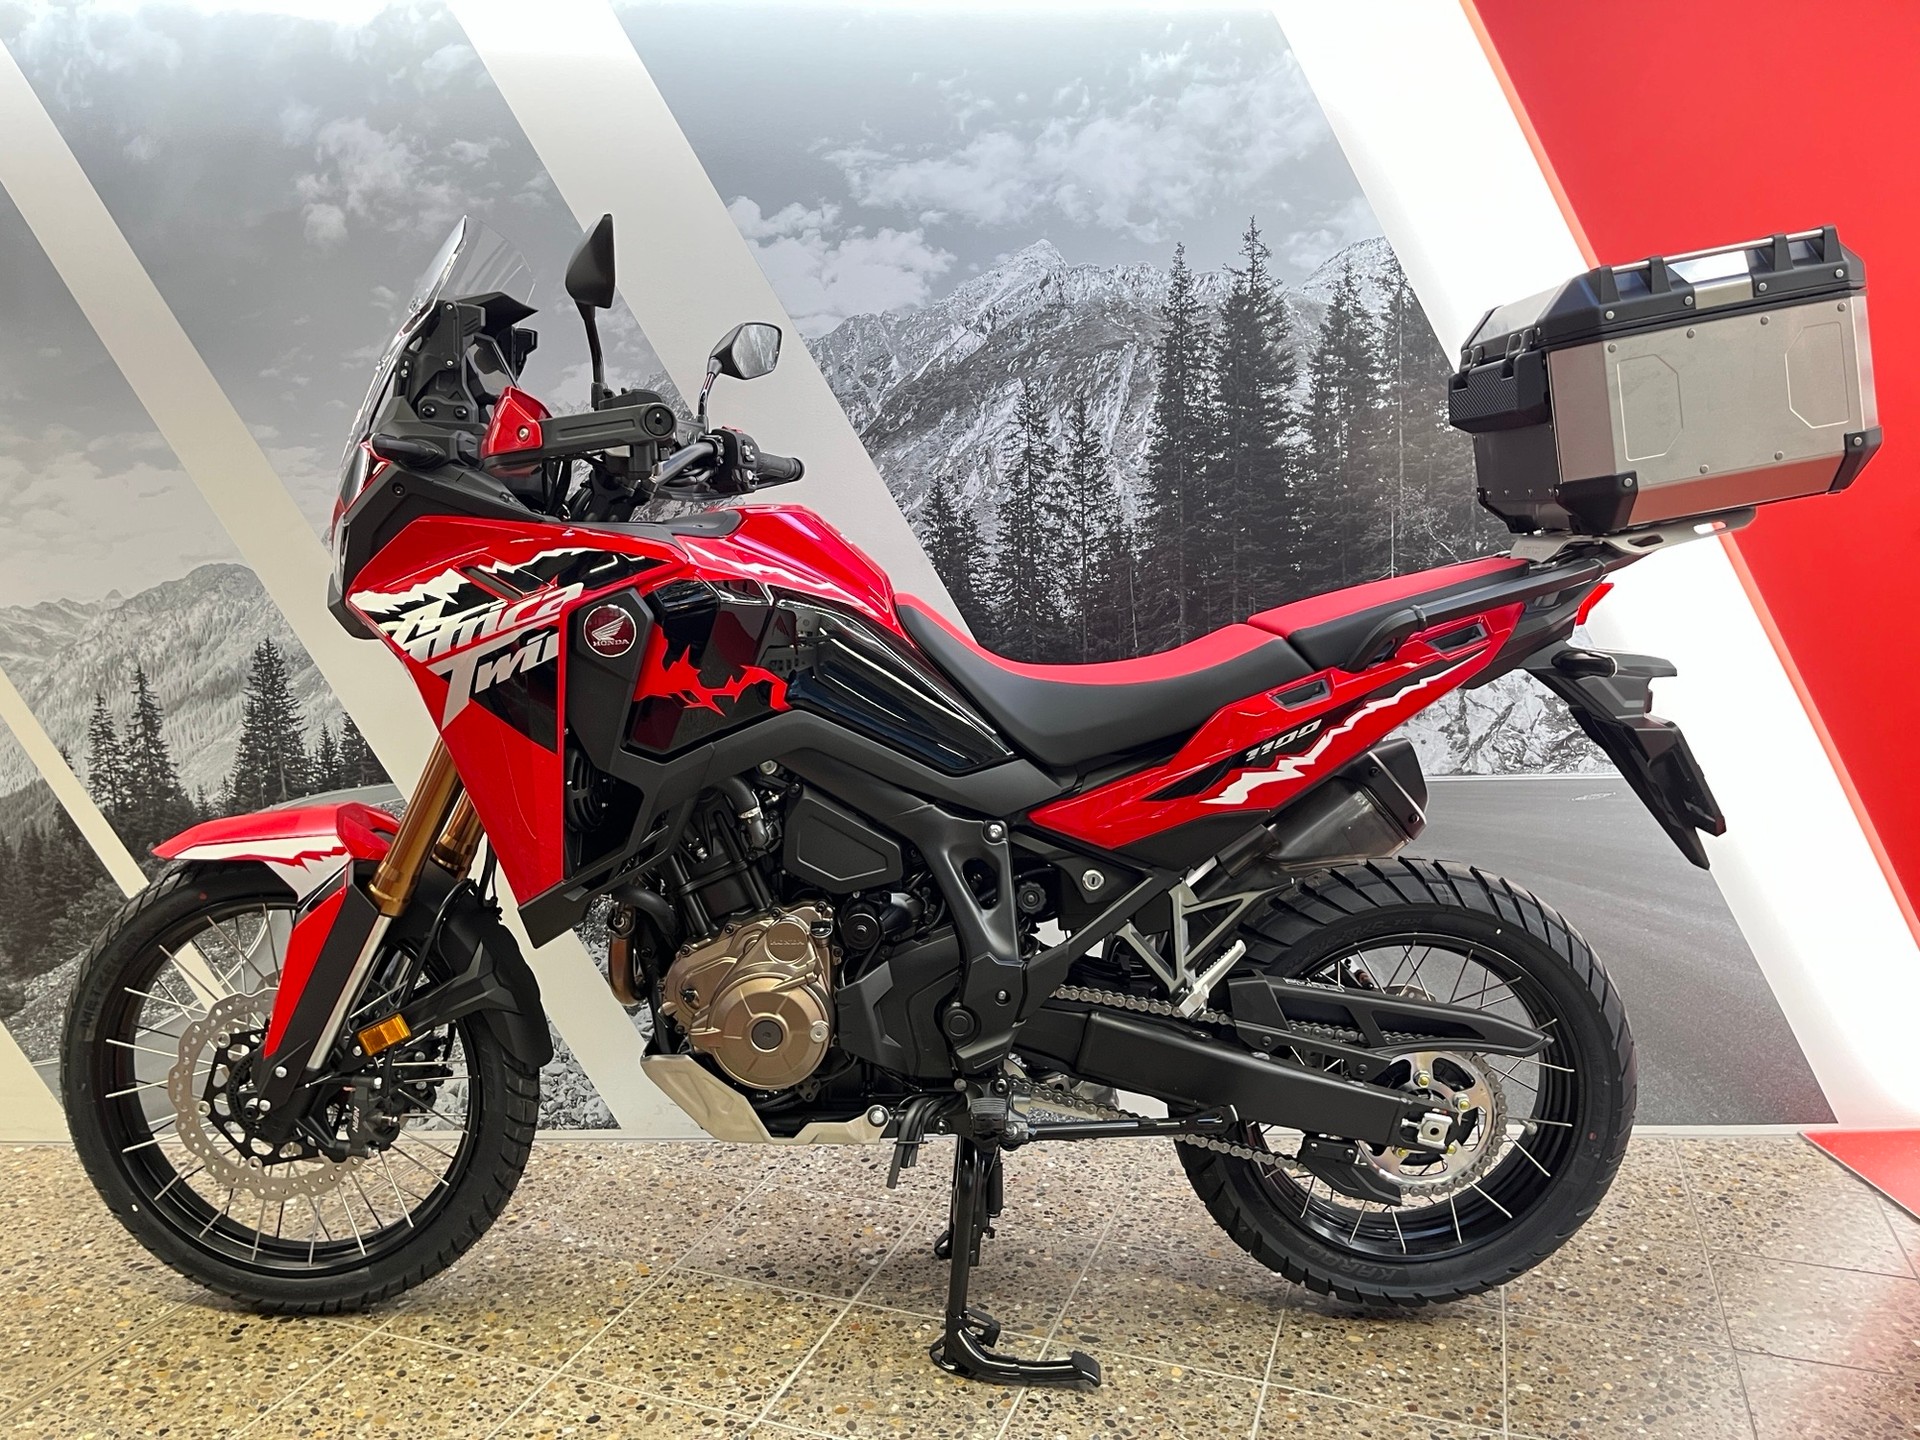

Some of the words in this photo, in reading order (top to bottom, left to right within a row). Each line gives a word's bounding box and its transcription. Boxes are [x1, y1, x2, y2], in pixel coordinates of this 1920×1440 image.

[379, 582, 583, 663] Africa
[593, 638, 629, 647] HONDA
[1246, 719, 1322, 762] 1100
